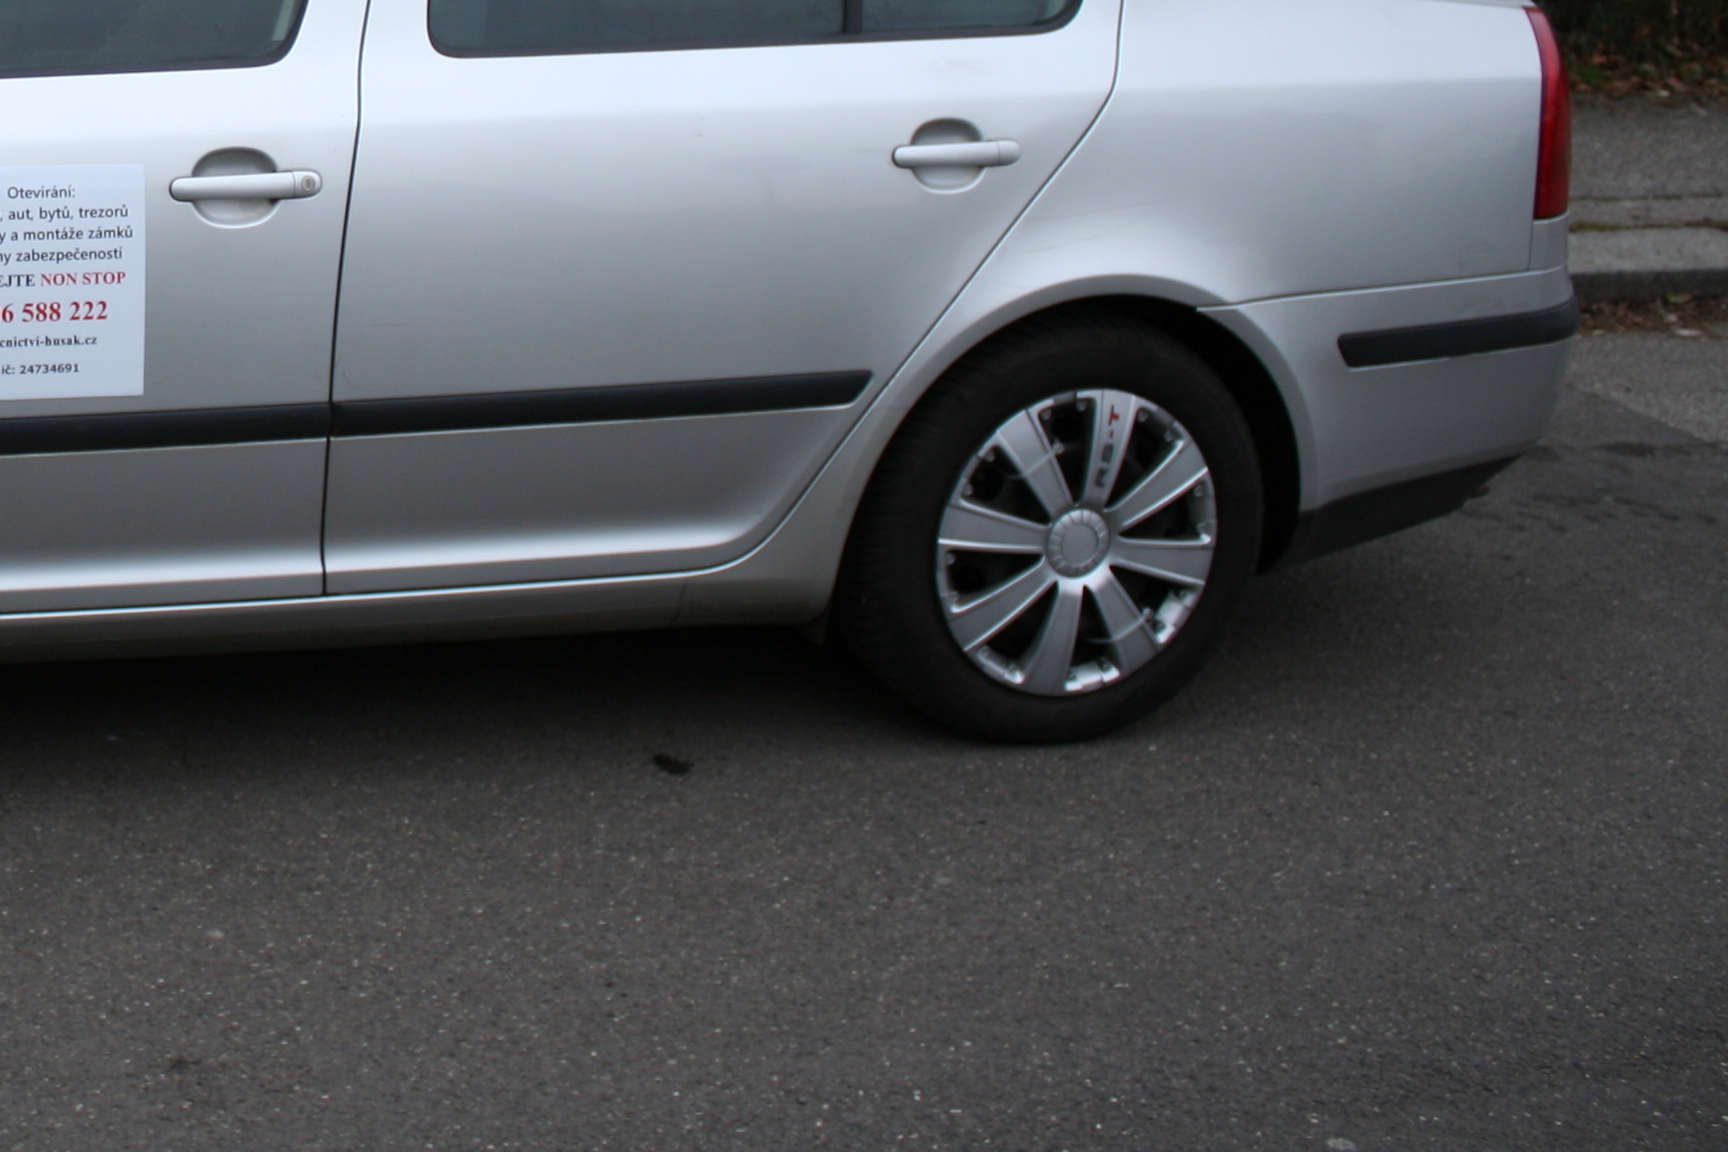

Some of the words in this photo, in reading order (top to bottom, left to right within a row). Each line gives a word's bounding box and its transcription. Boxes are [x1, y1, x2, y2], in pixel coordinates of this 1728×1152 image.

[7, 185, 76, 199] Otevírání:
[8, 208, 34, 221] aut,
[39, 206, 74, 222] bytů,
[79, 204, 128, 219] trezorů
[10, 231, 19, 241] a
[23, 226, 84, 241] montáže
[88, 225, 133, 239] zámků
[40, 273, 77, 287] NON
[82, 271, 126, 286] STOP
[21, 302, 62, 323] 588
[69, 300, 109, 321] 222
[19, 363, 80, 375] 24734691
